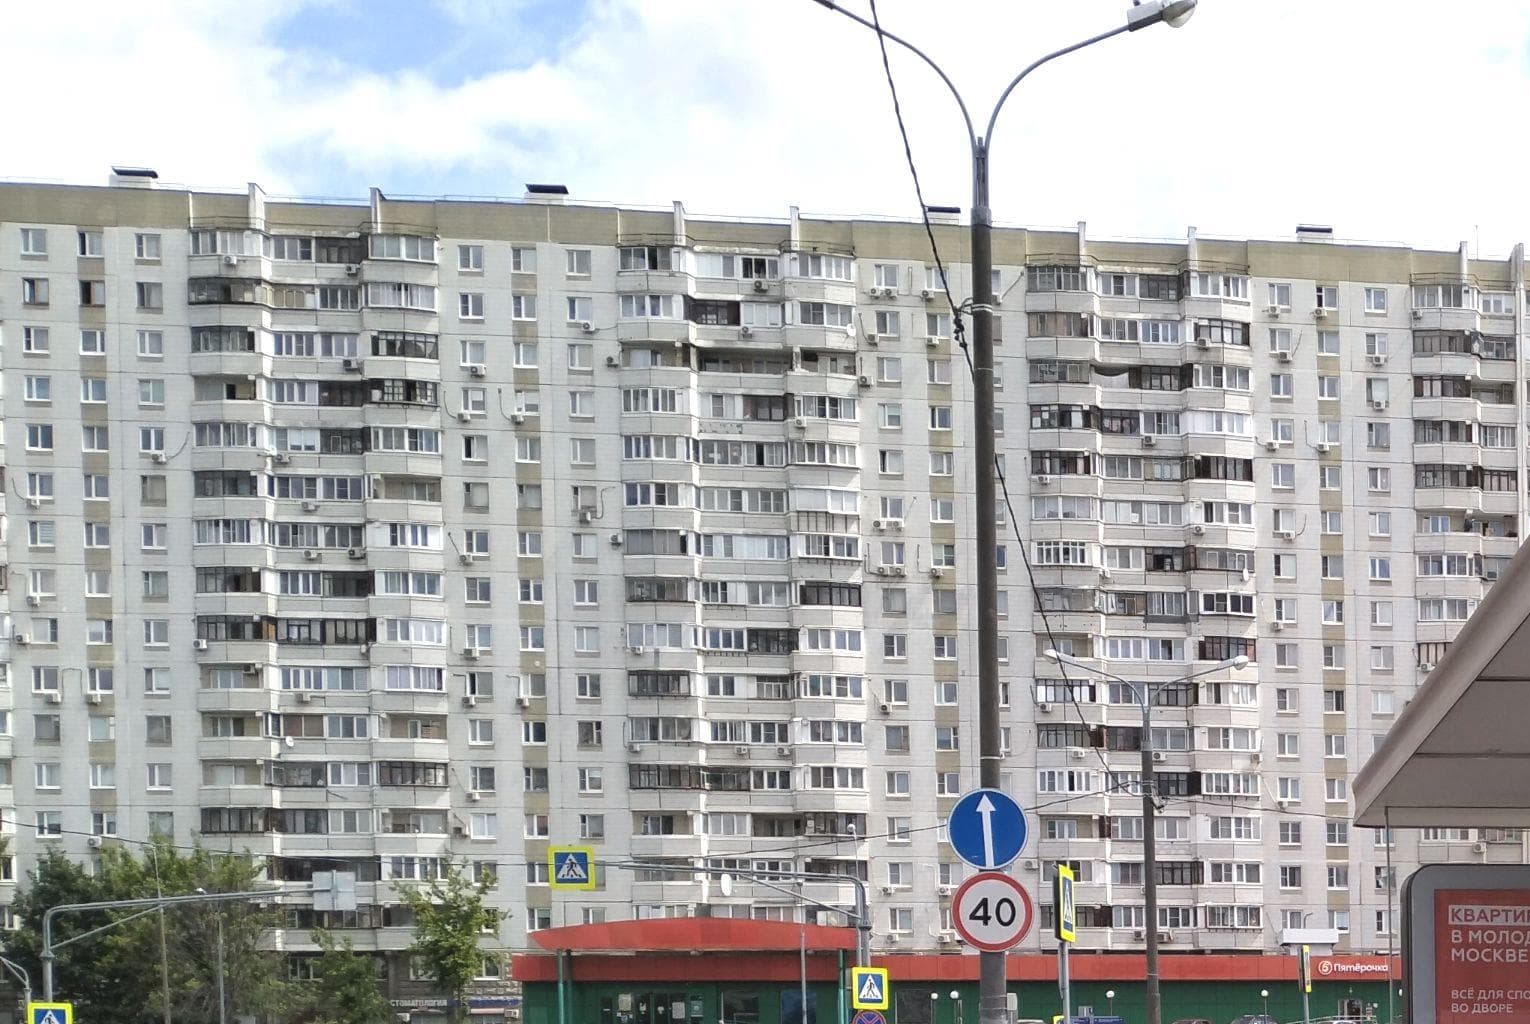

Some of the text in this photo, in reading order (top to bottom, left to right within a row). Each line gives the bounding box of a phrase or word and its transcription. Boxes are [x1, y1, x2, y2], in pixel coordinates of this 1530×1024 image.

[969, 897, 1016, 927] 40
[1451, 930, 1462, 944] В
[1451, 949, 1528, 962] МОСКВЕ
[1334, 962, 1388, 973] Пятёрочка
[1451, 988, 1474, 1000] ВСЁ
[1477, 990, 1503, 1002] ДЛЯ
[1451, 1003, 1514, 1015] ВО ДВОРЕ
